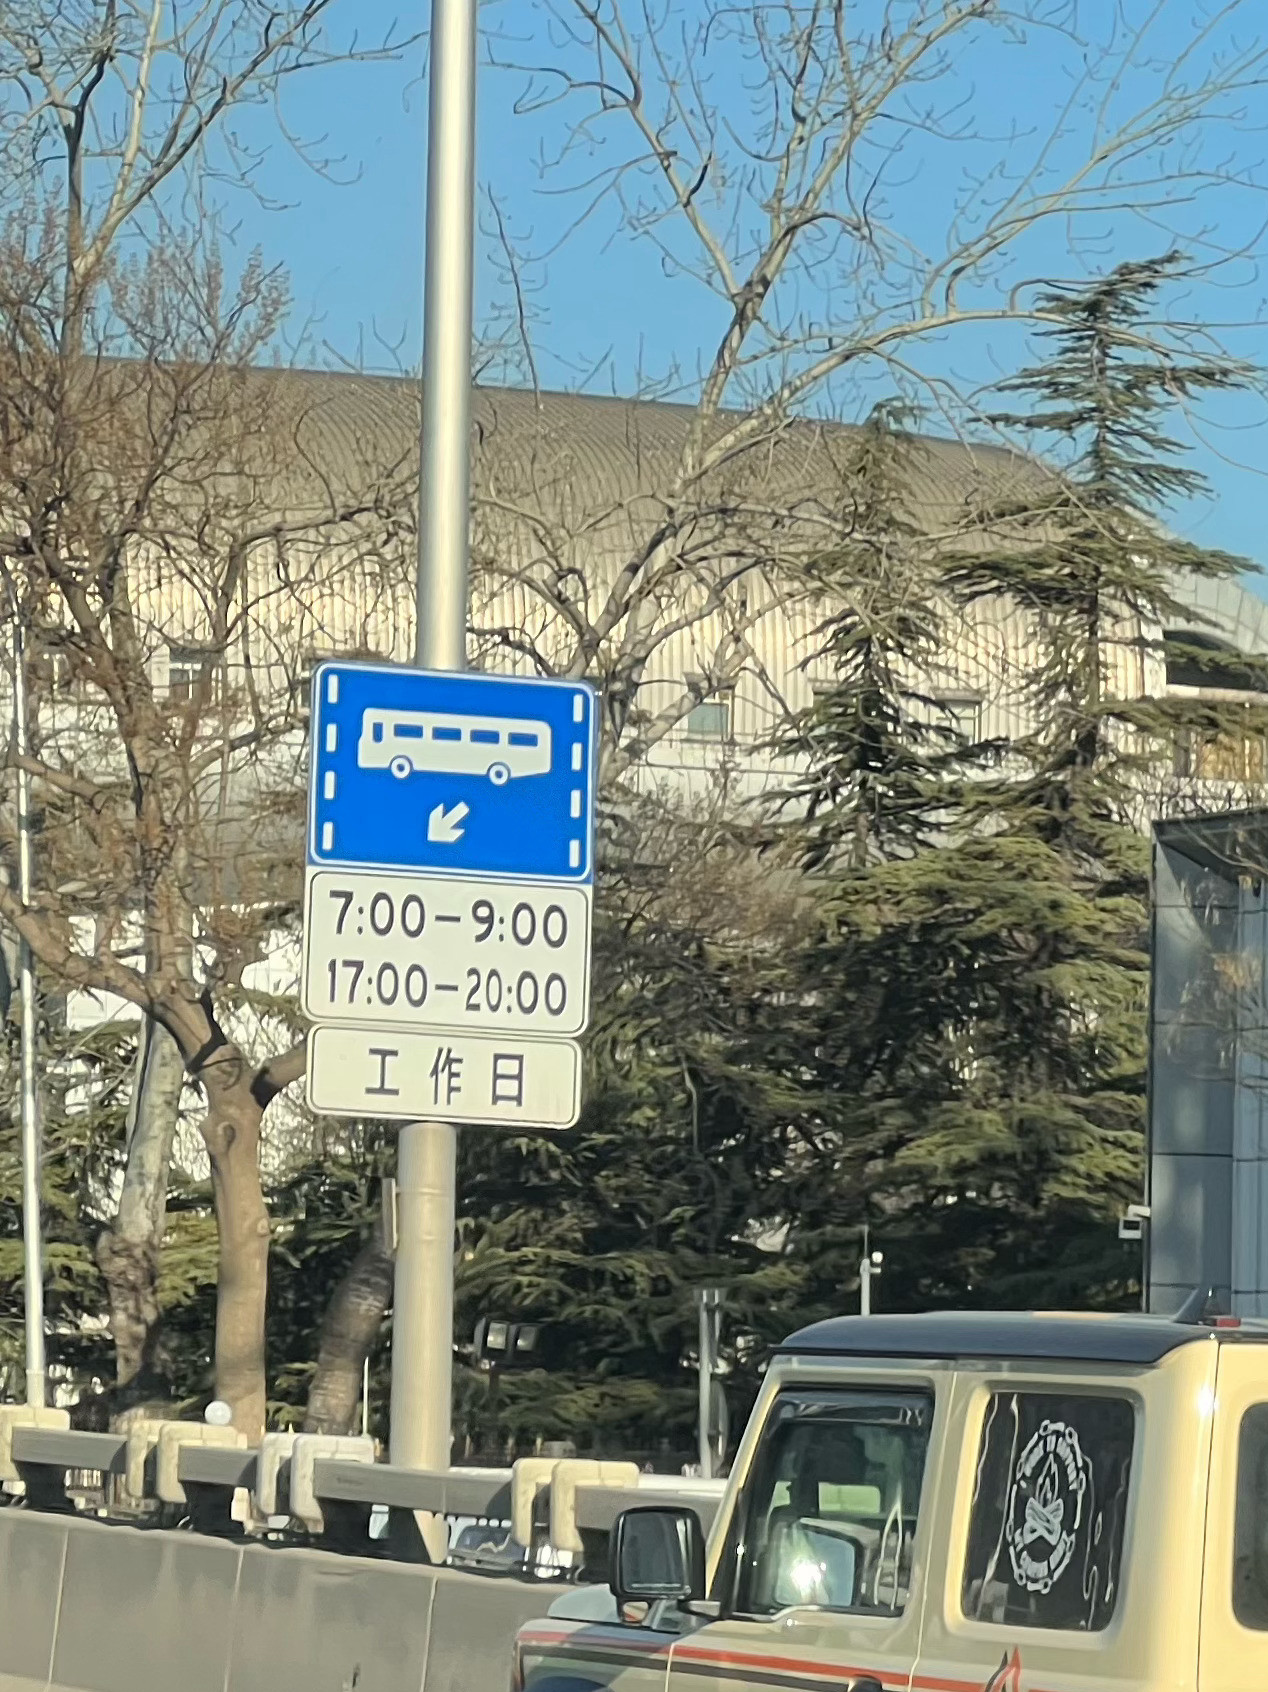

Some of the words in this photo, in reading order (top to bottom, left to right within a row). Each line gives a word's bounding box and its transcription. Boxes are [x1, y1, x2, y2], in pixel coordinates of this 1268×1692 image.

[329, 890, 568, 948] 7:00-9:00
[328, 957, 568, 1017] 17:00-20:00
[364, 1046, 525, 1107] 工作日
